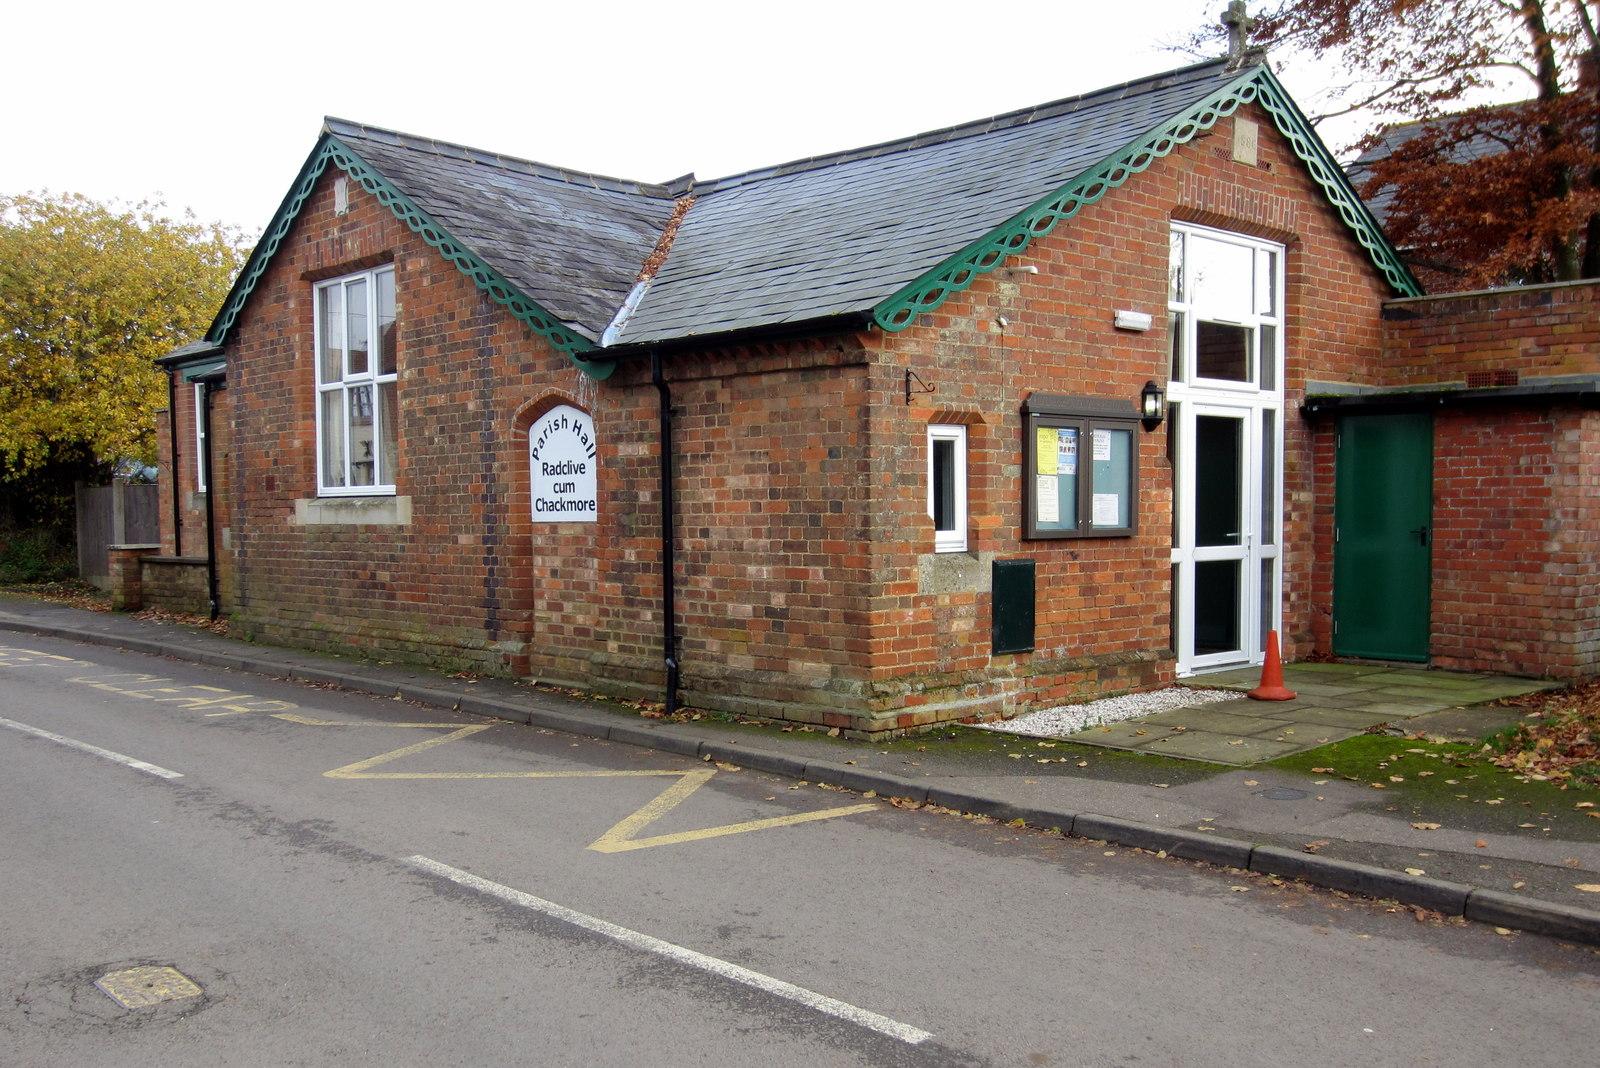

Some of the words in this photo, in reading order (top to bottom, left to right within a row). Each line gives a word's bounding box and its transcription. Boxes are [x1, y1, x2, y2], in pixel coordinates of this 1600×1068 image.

[532, 414, 568, 461] Parish
[572, 419, 597, 459] Hall
[542, 460, 586, 476] Radclive
[553, 481, 575, 493] cum
[535, 498, 596, 512] Chackmore
[65, 673, 300, 717] CLEAR
